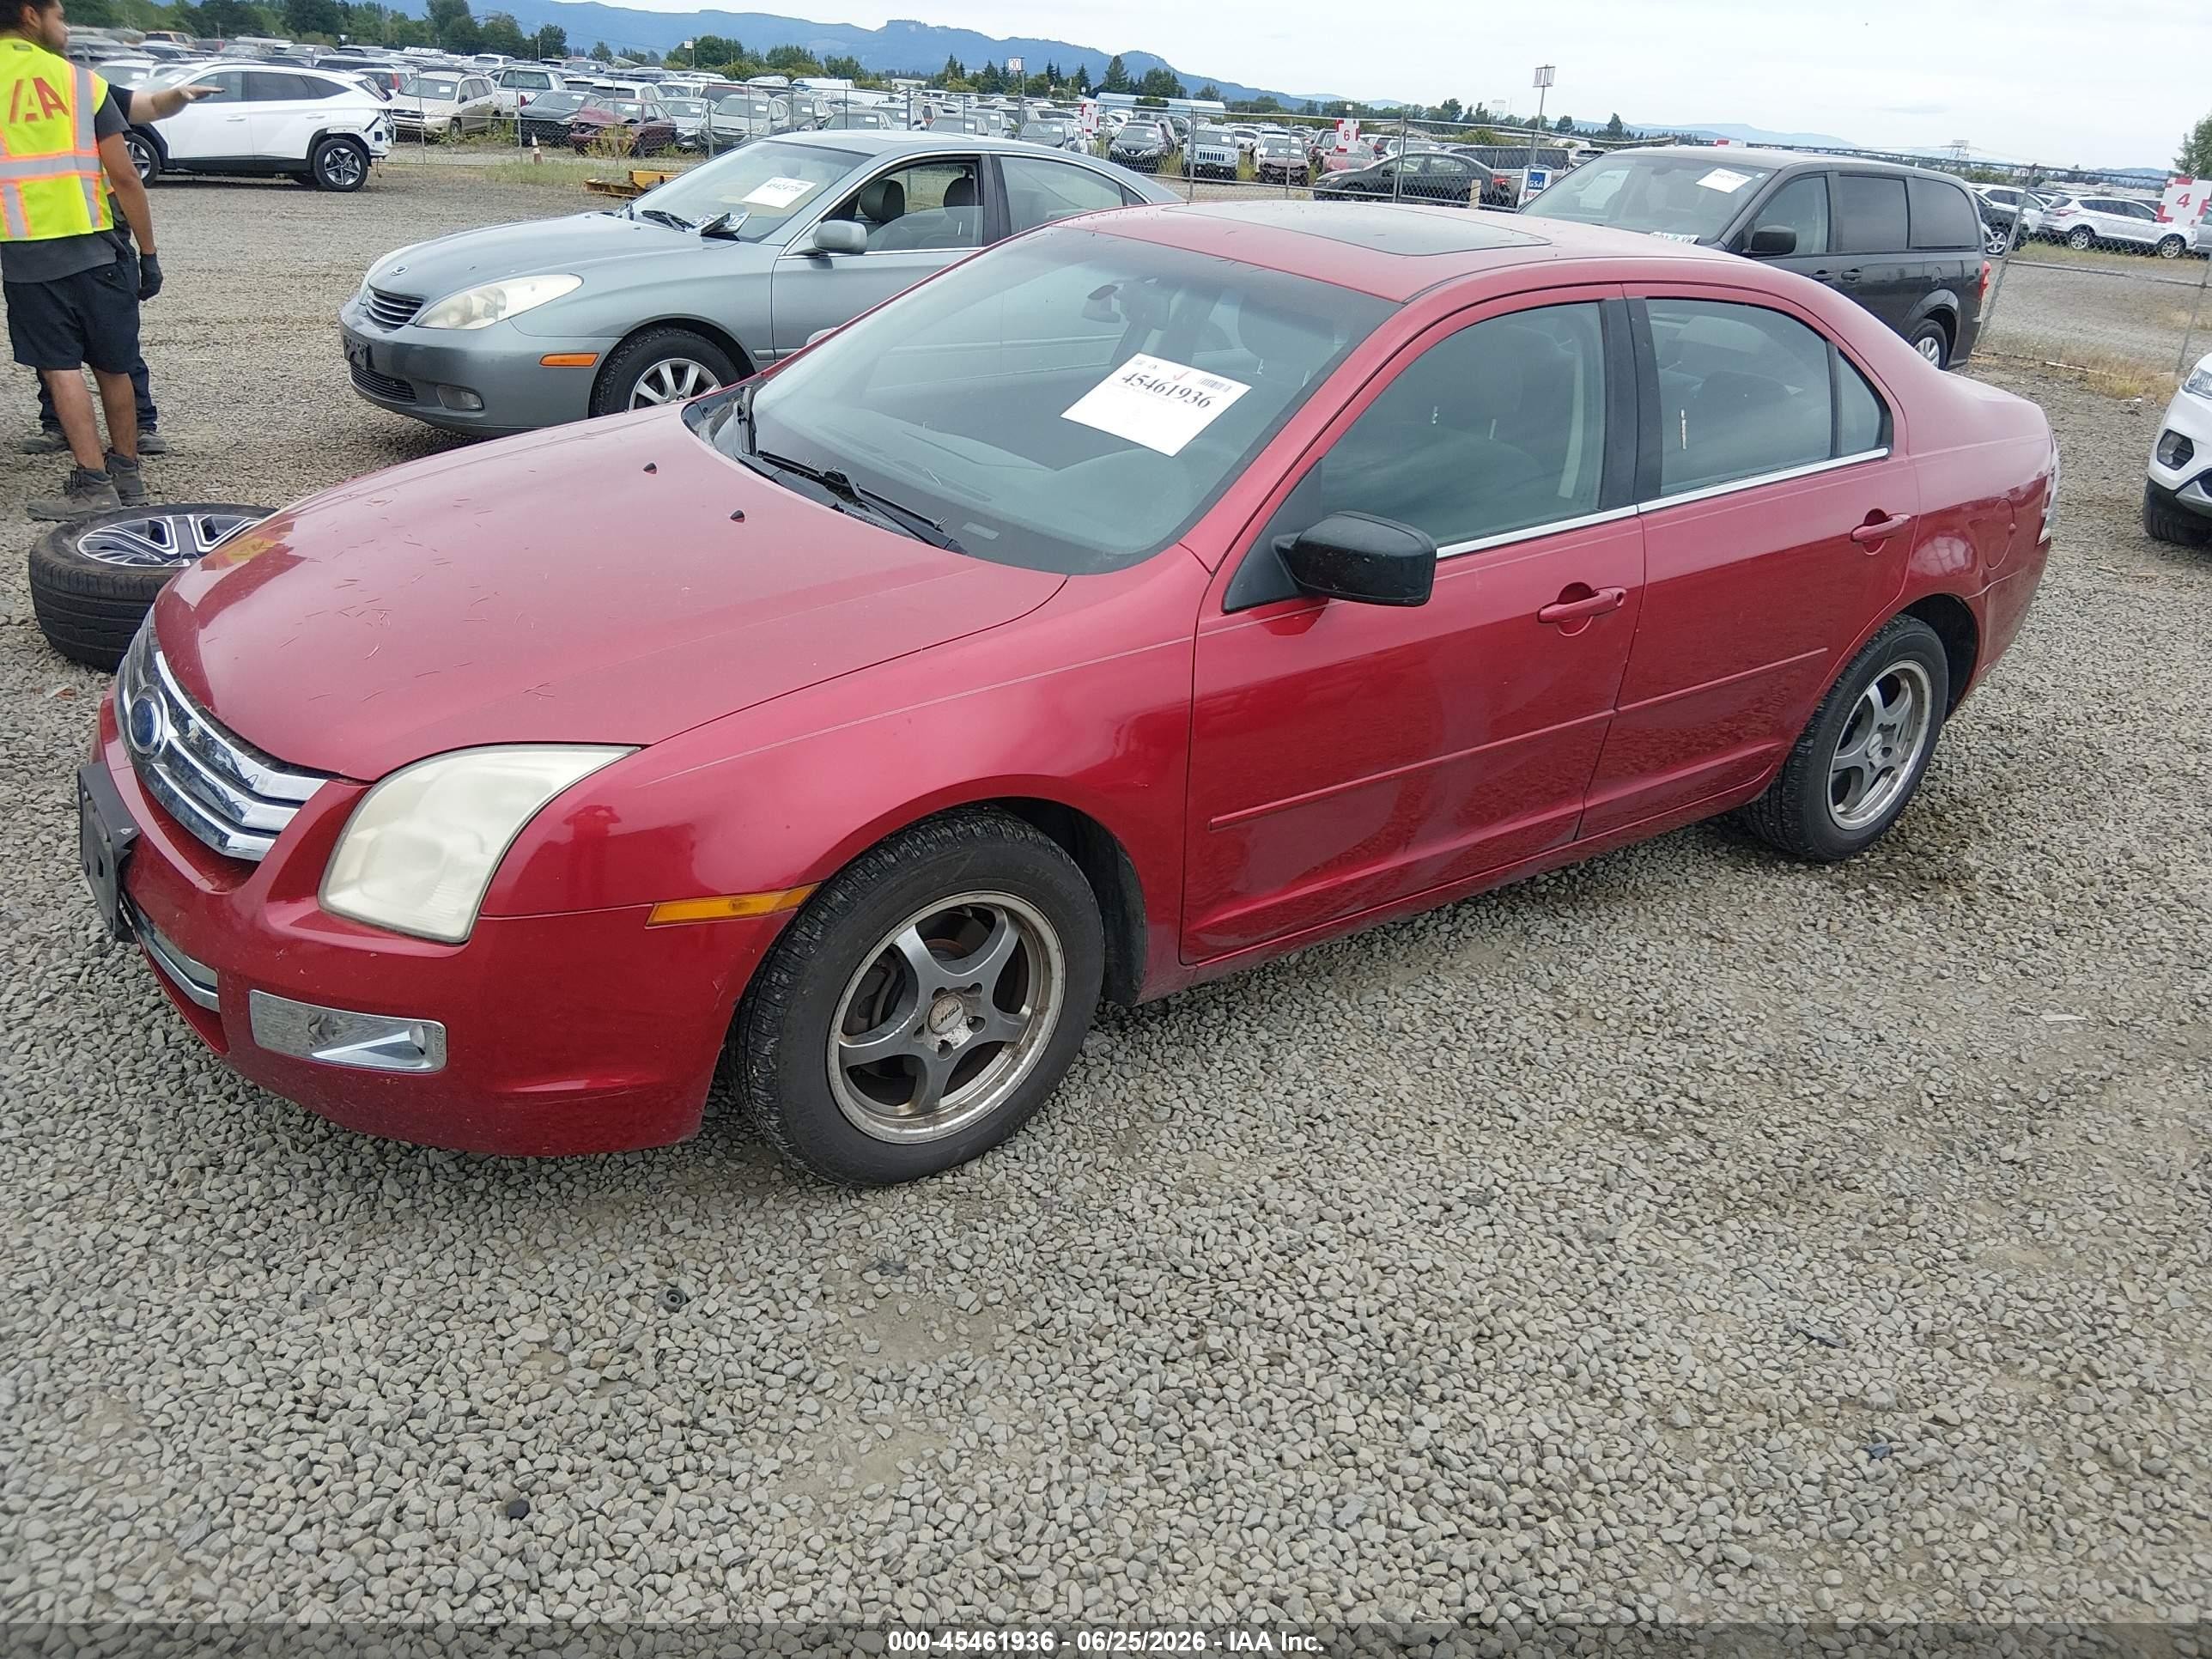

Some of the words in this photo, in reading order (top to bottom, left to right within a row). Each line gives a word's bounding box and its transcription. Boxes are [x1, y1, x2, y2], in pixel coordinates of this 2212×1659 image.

[1009, 59, 1019, 70] 30
[1087, 112, 1093, 123] 7
[1343, 130, 1351, 142] 6
[2176, 193, 2191, 208] 4
[1121, 373, 1216, 409] 45461936
